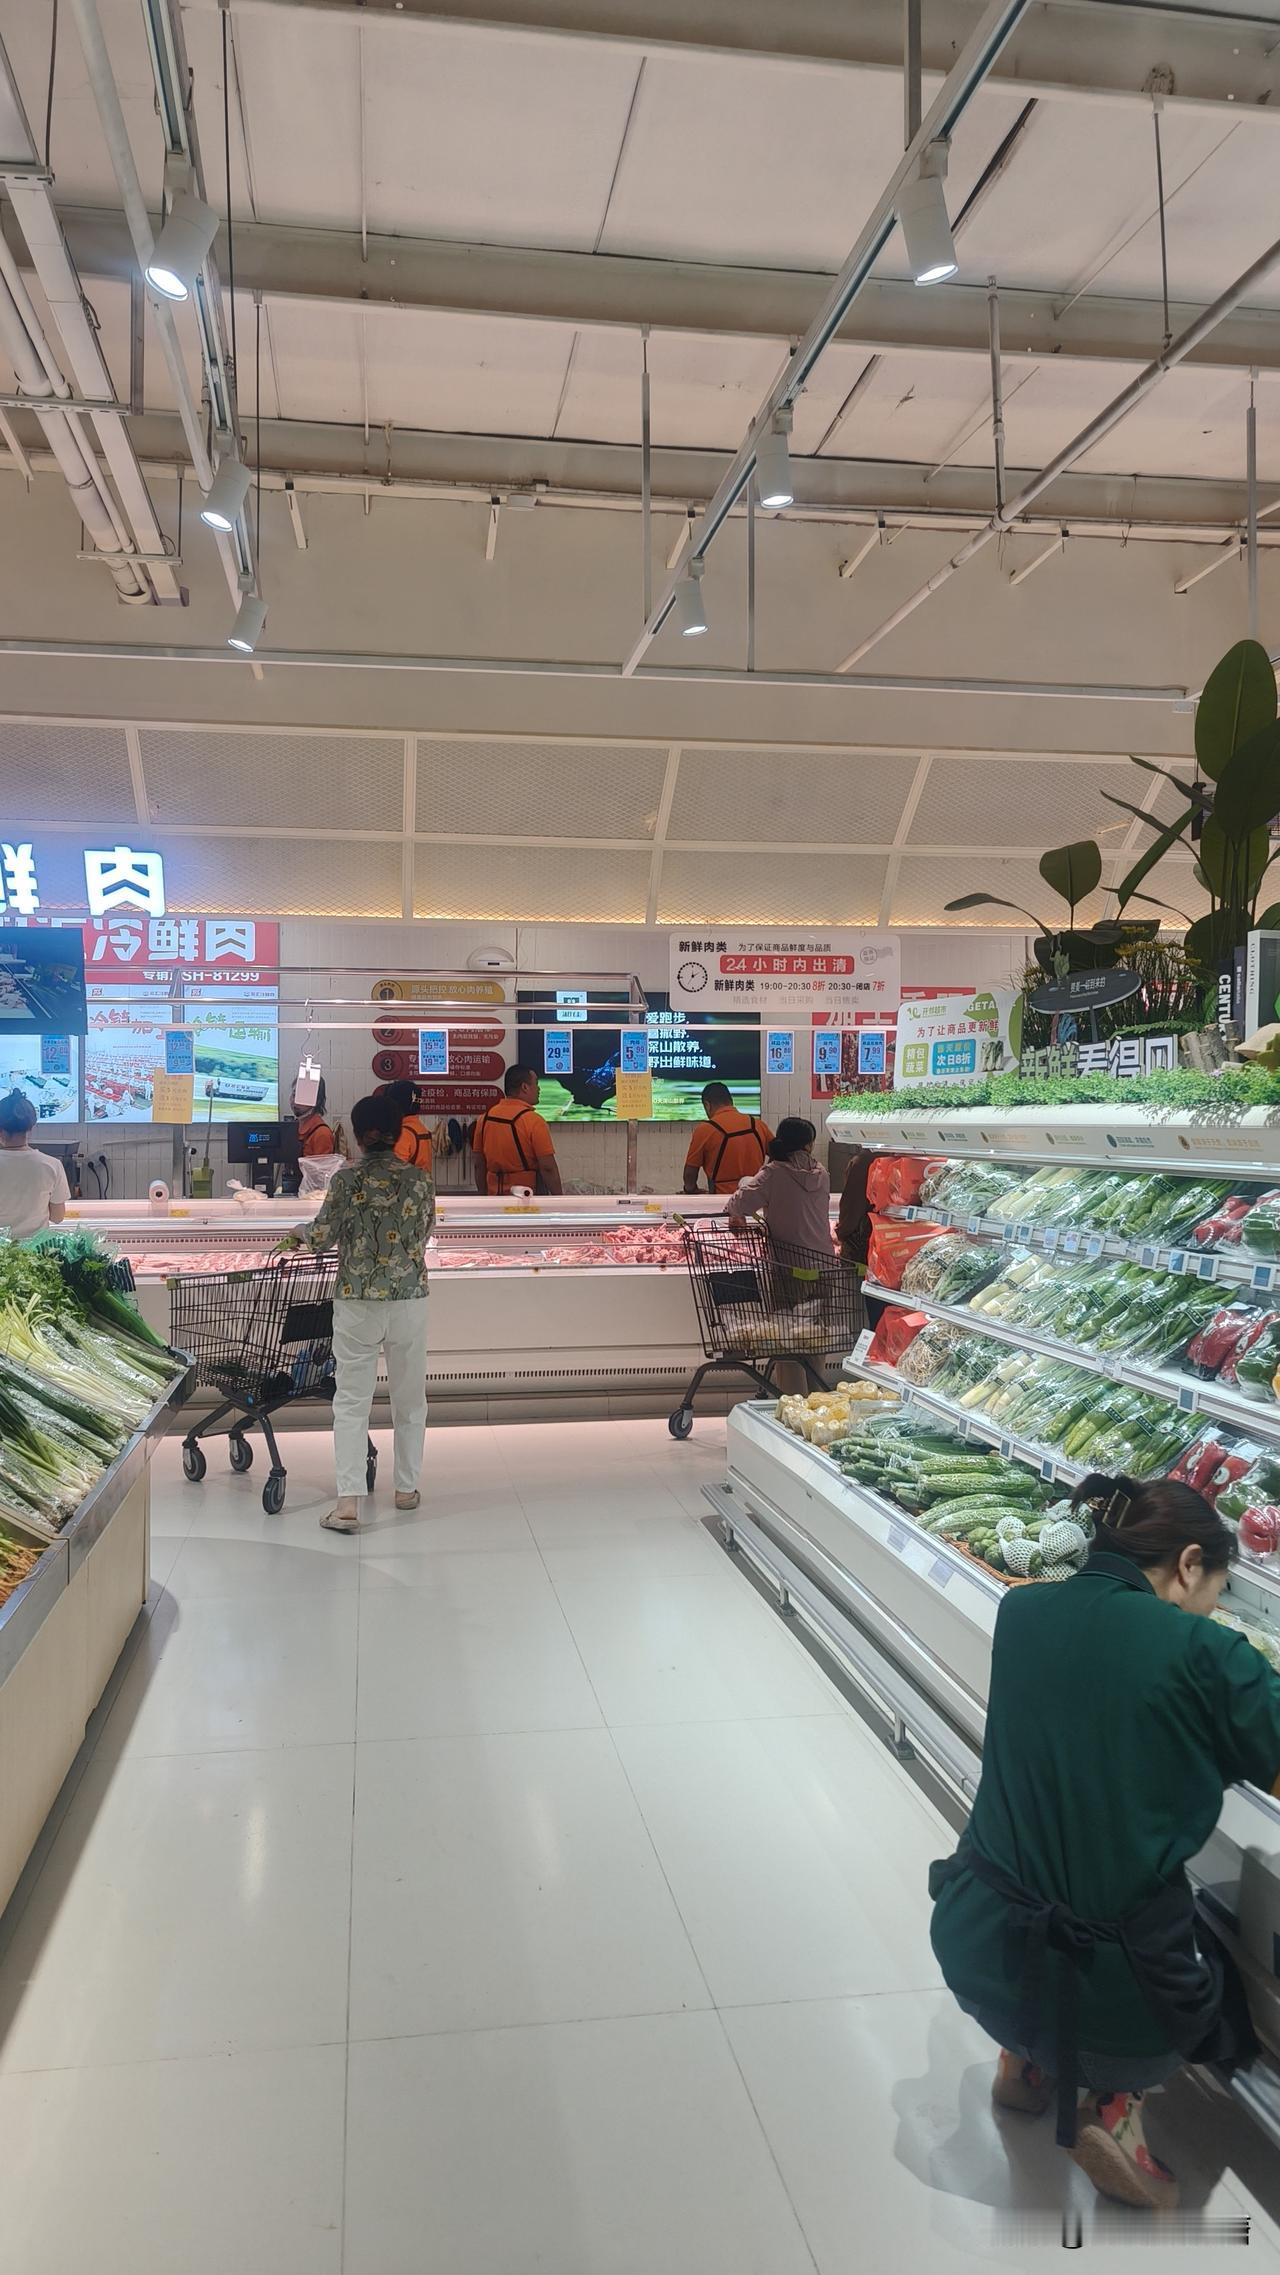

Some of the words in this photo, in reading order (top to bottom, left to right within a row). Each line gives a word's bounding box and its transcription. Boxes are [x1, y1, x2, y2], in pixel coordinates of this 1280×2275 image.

[678, 941, 727, 953] 新鲜肉类
[737, 943, 832, 953] 为了保证商品鲜度与品质
[726, 957, 847, 973] 24小时内出清
[714, 979, 756, 993] 新鲜肉类
[760, 981, 812, 991] 19:00-20:30
[812, 980, 826, 992] 8折
[872, 980, 886, 992] 7折
[917, 1019, 999, 1038] 为了让商品更新鲜
[383, 1059, 391, 1071] 3
[936, 1053, 972, 1066] 次日8折
